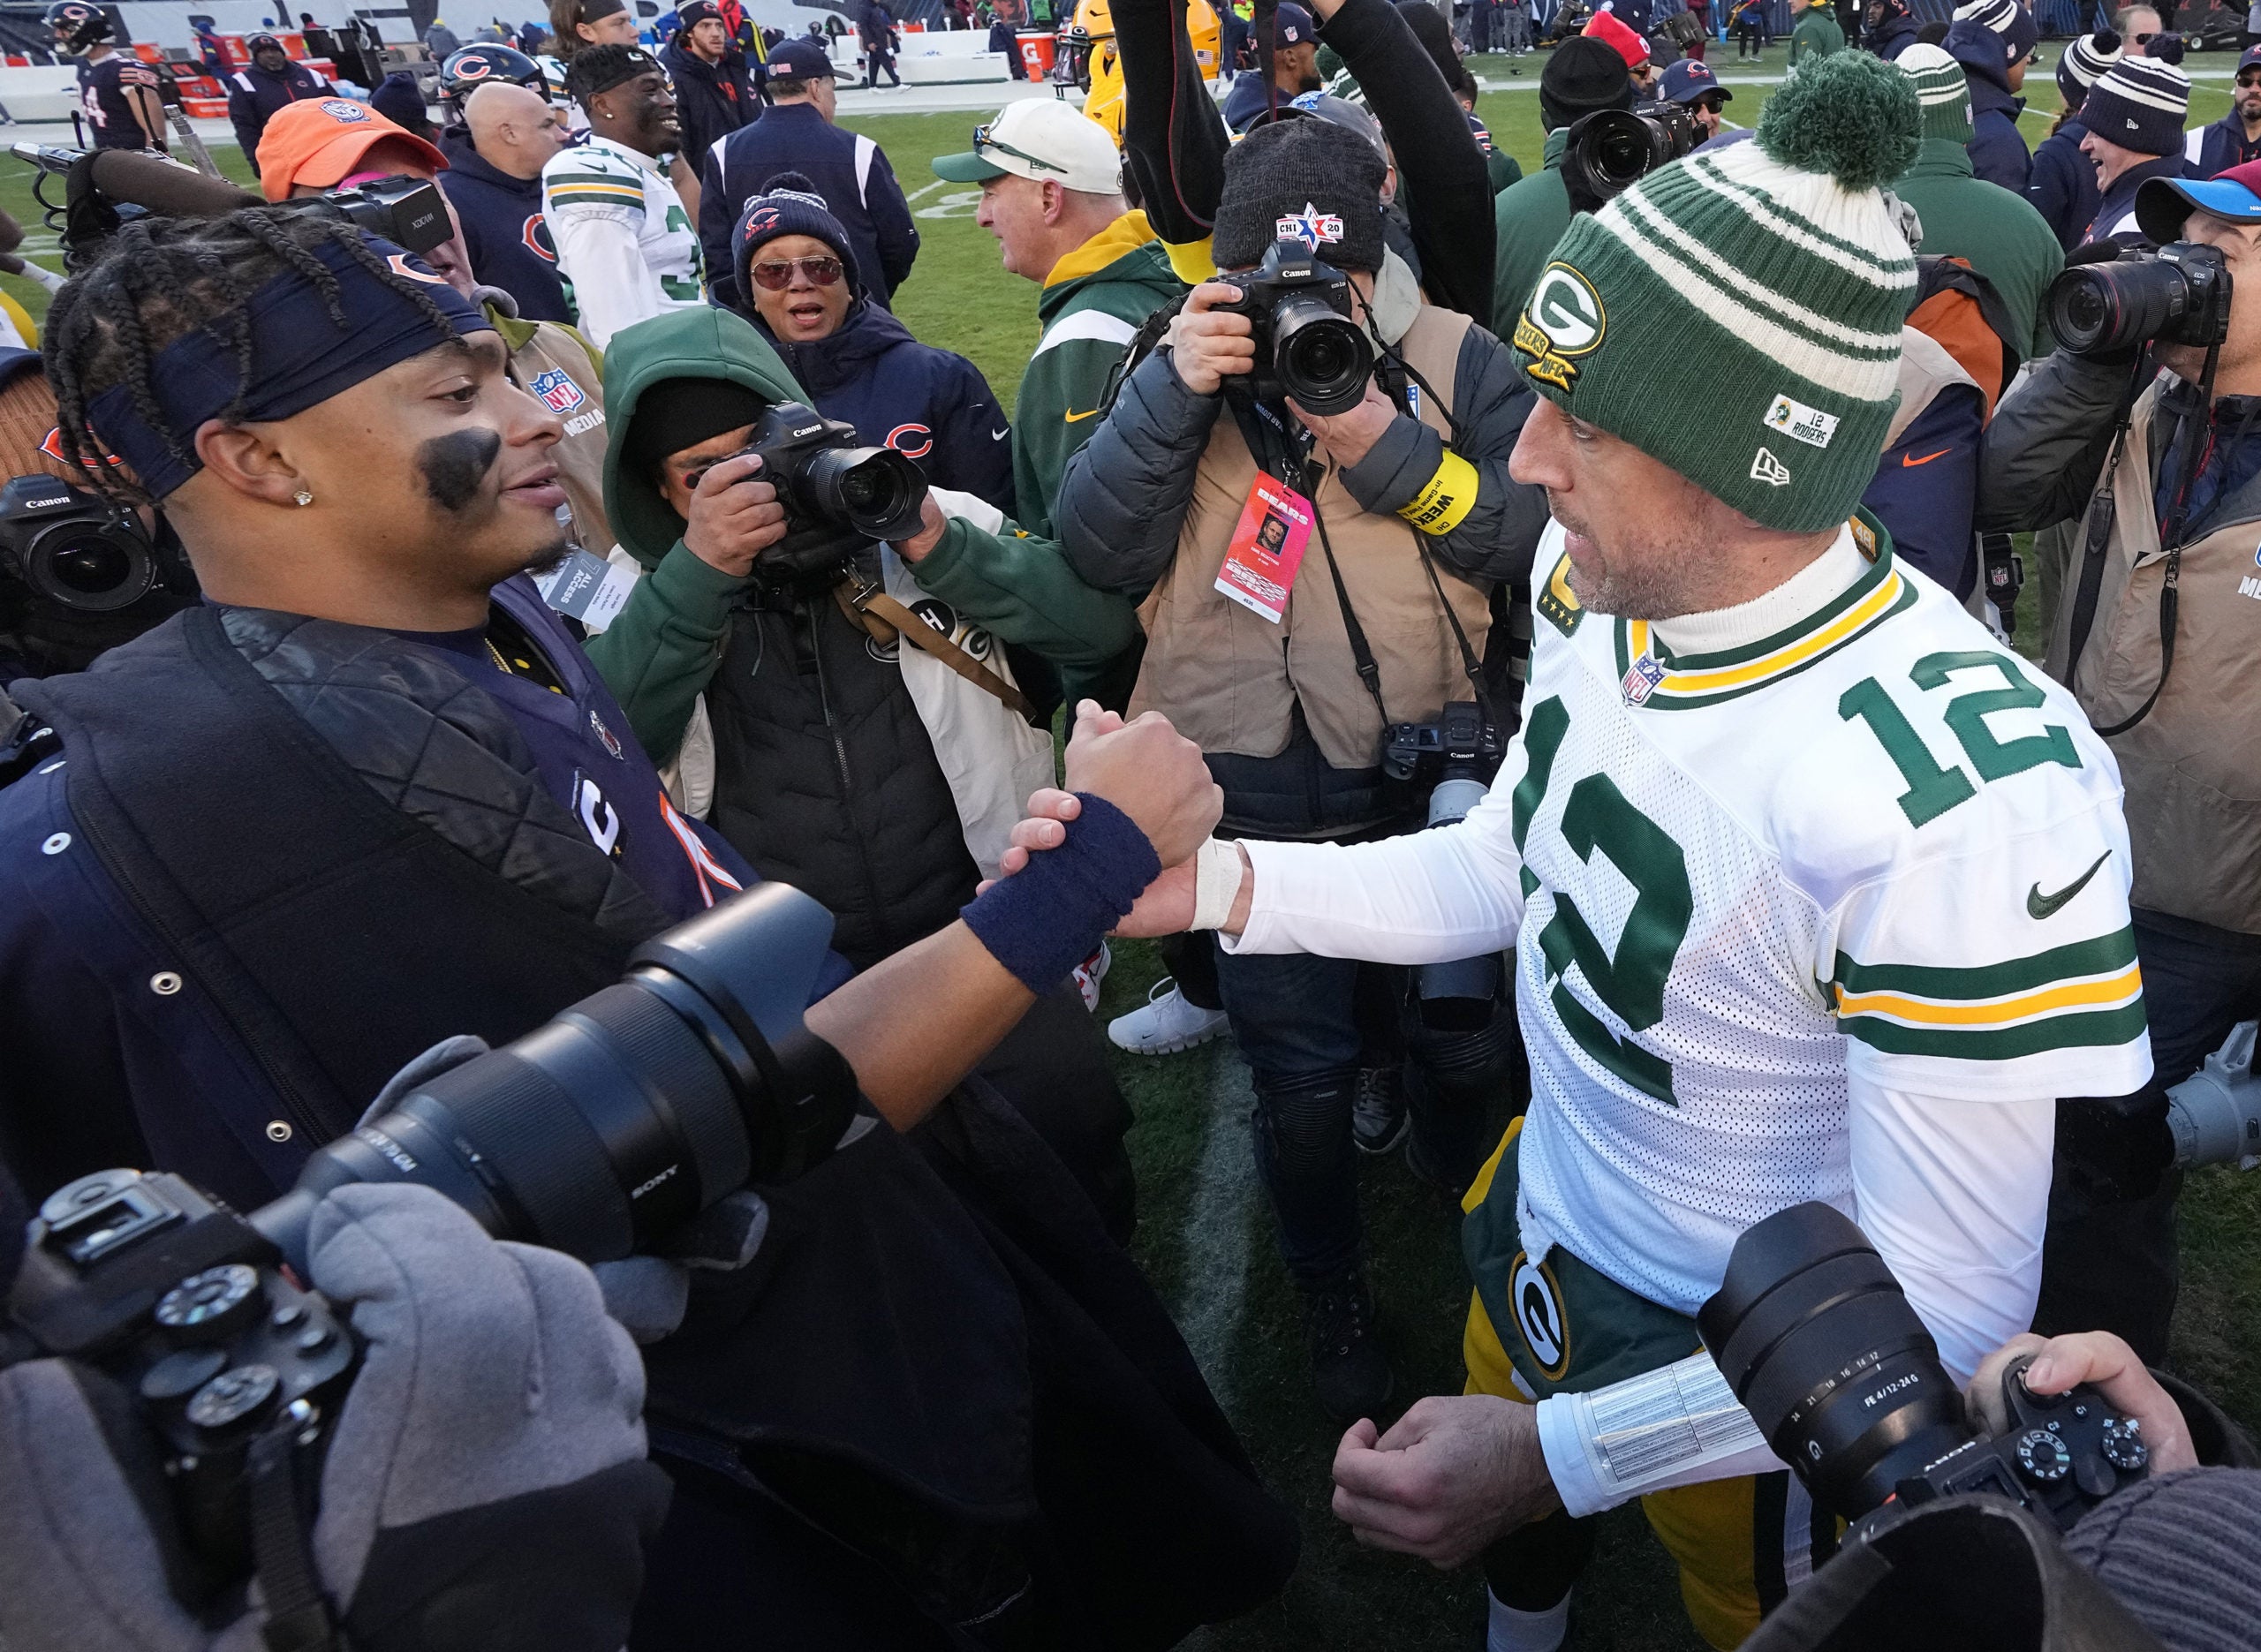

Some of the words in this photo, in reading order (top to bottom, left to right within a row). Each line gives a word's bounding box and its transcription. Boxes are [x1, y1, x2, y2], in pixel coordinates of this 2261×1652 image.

[1022, 42, 1042, 64] G
[1280, 223, 1297, 233] CHI
[1327, 223, 1340, 232] 20
[2158, 252, 2180, 262] Canon
[1282, 269, 1312, 278] Canon
[1531, 269, 1598, 347] G
[1516, 321, 1546, 354] ACKERS
[1539, 358, 1566, 379] NFC
[543, 383, 580, 410] NFL
[563, 408, 606, 437] MEDIA
[793, 424, 822, 438] Canon
[1791, 422, 1827, 444] RODGERS
[1809, 412, 1825, 428] 12
[25, 495, 72, 509] Canon
[1257, 487, 1309, 526] BEARS
[1413, 494, 1455, 526] WEEK
[1855, 524, 1872, 548] 48
[561, 569, 585, 605] ACCESS
[578, 572, 593, 590] ALL
[1625, 668, 1649, 700] NFL
[1837, 649, 2083, 829] 12
[579, 779, 620, 856] C
[631, 1163, 678, 1200] SONY
[1515, 1264, 1561, 1366] G
[1791, 1412, 1801, 1422] 24
[1806, 1395, 1817, 1407] 21
[1825, 1379, 1835, 1390] 18
[1840, 1369, 1850, 1378] 16
[1856, 1358, 1866, 1369] 14
[1869, 1351, 1879, 1361] 12
[1864, 1395, 1878, 1408] FE
[1909, 1373, 1919, 1384] G
[1808, 1439, 1824, 1461] G
